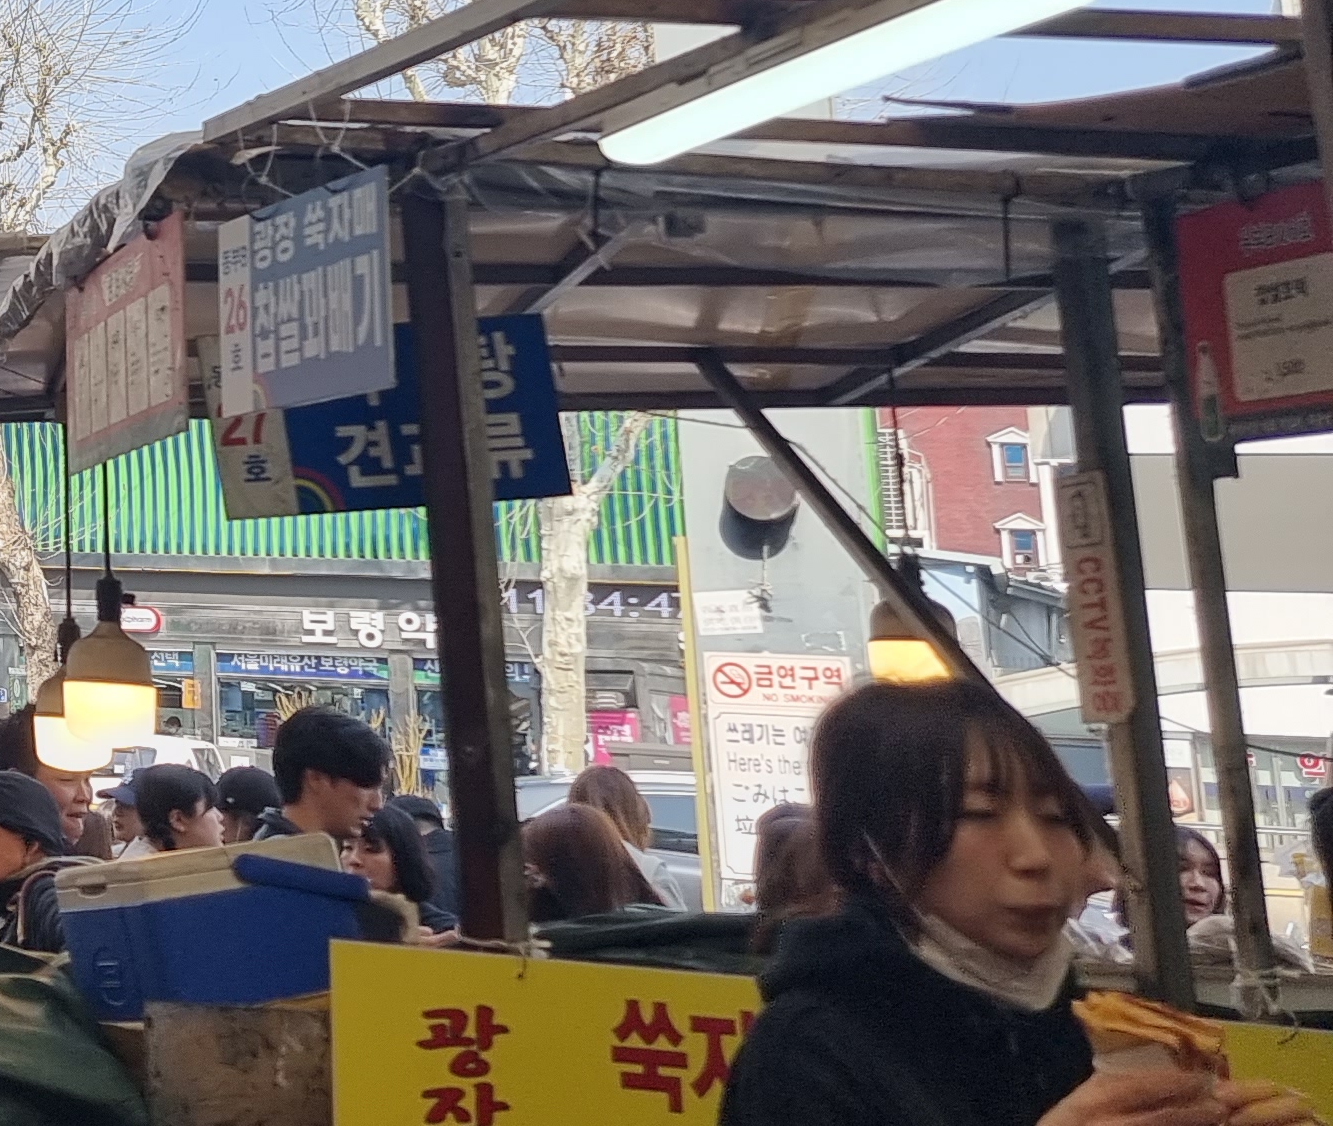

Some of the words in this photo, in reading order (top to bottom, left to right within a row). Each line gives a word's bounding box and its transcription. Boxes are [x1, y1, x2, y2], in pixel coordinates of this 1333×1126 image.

[223, 283, 248, 336] 26
[243, 454, 272, 483] 호
[150, 651, 180, 667] 선택
[230, 652, 318, 672] 서울미래유산
[320, 655, 380, 675] 보령약국
[753, 663, 844, 694] 금연구역
[763, 692, 778, 703] NO
[726, 722, 786, 747] 쓰레기는
[727, 750, 774, 775] Here's
[777, 755, 802, 775] the
